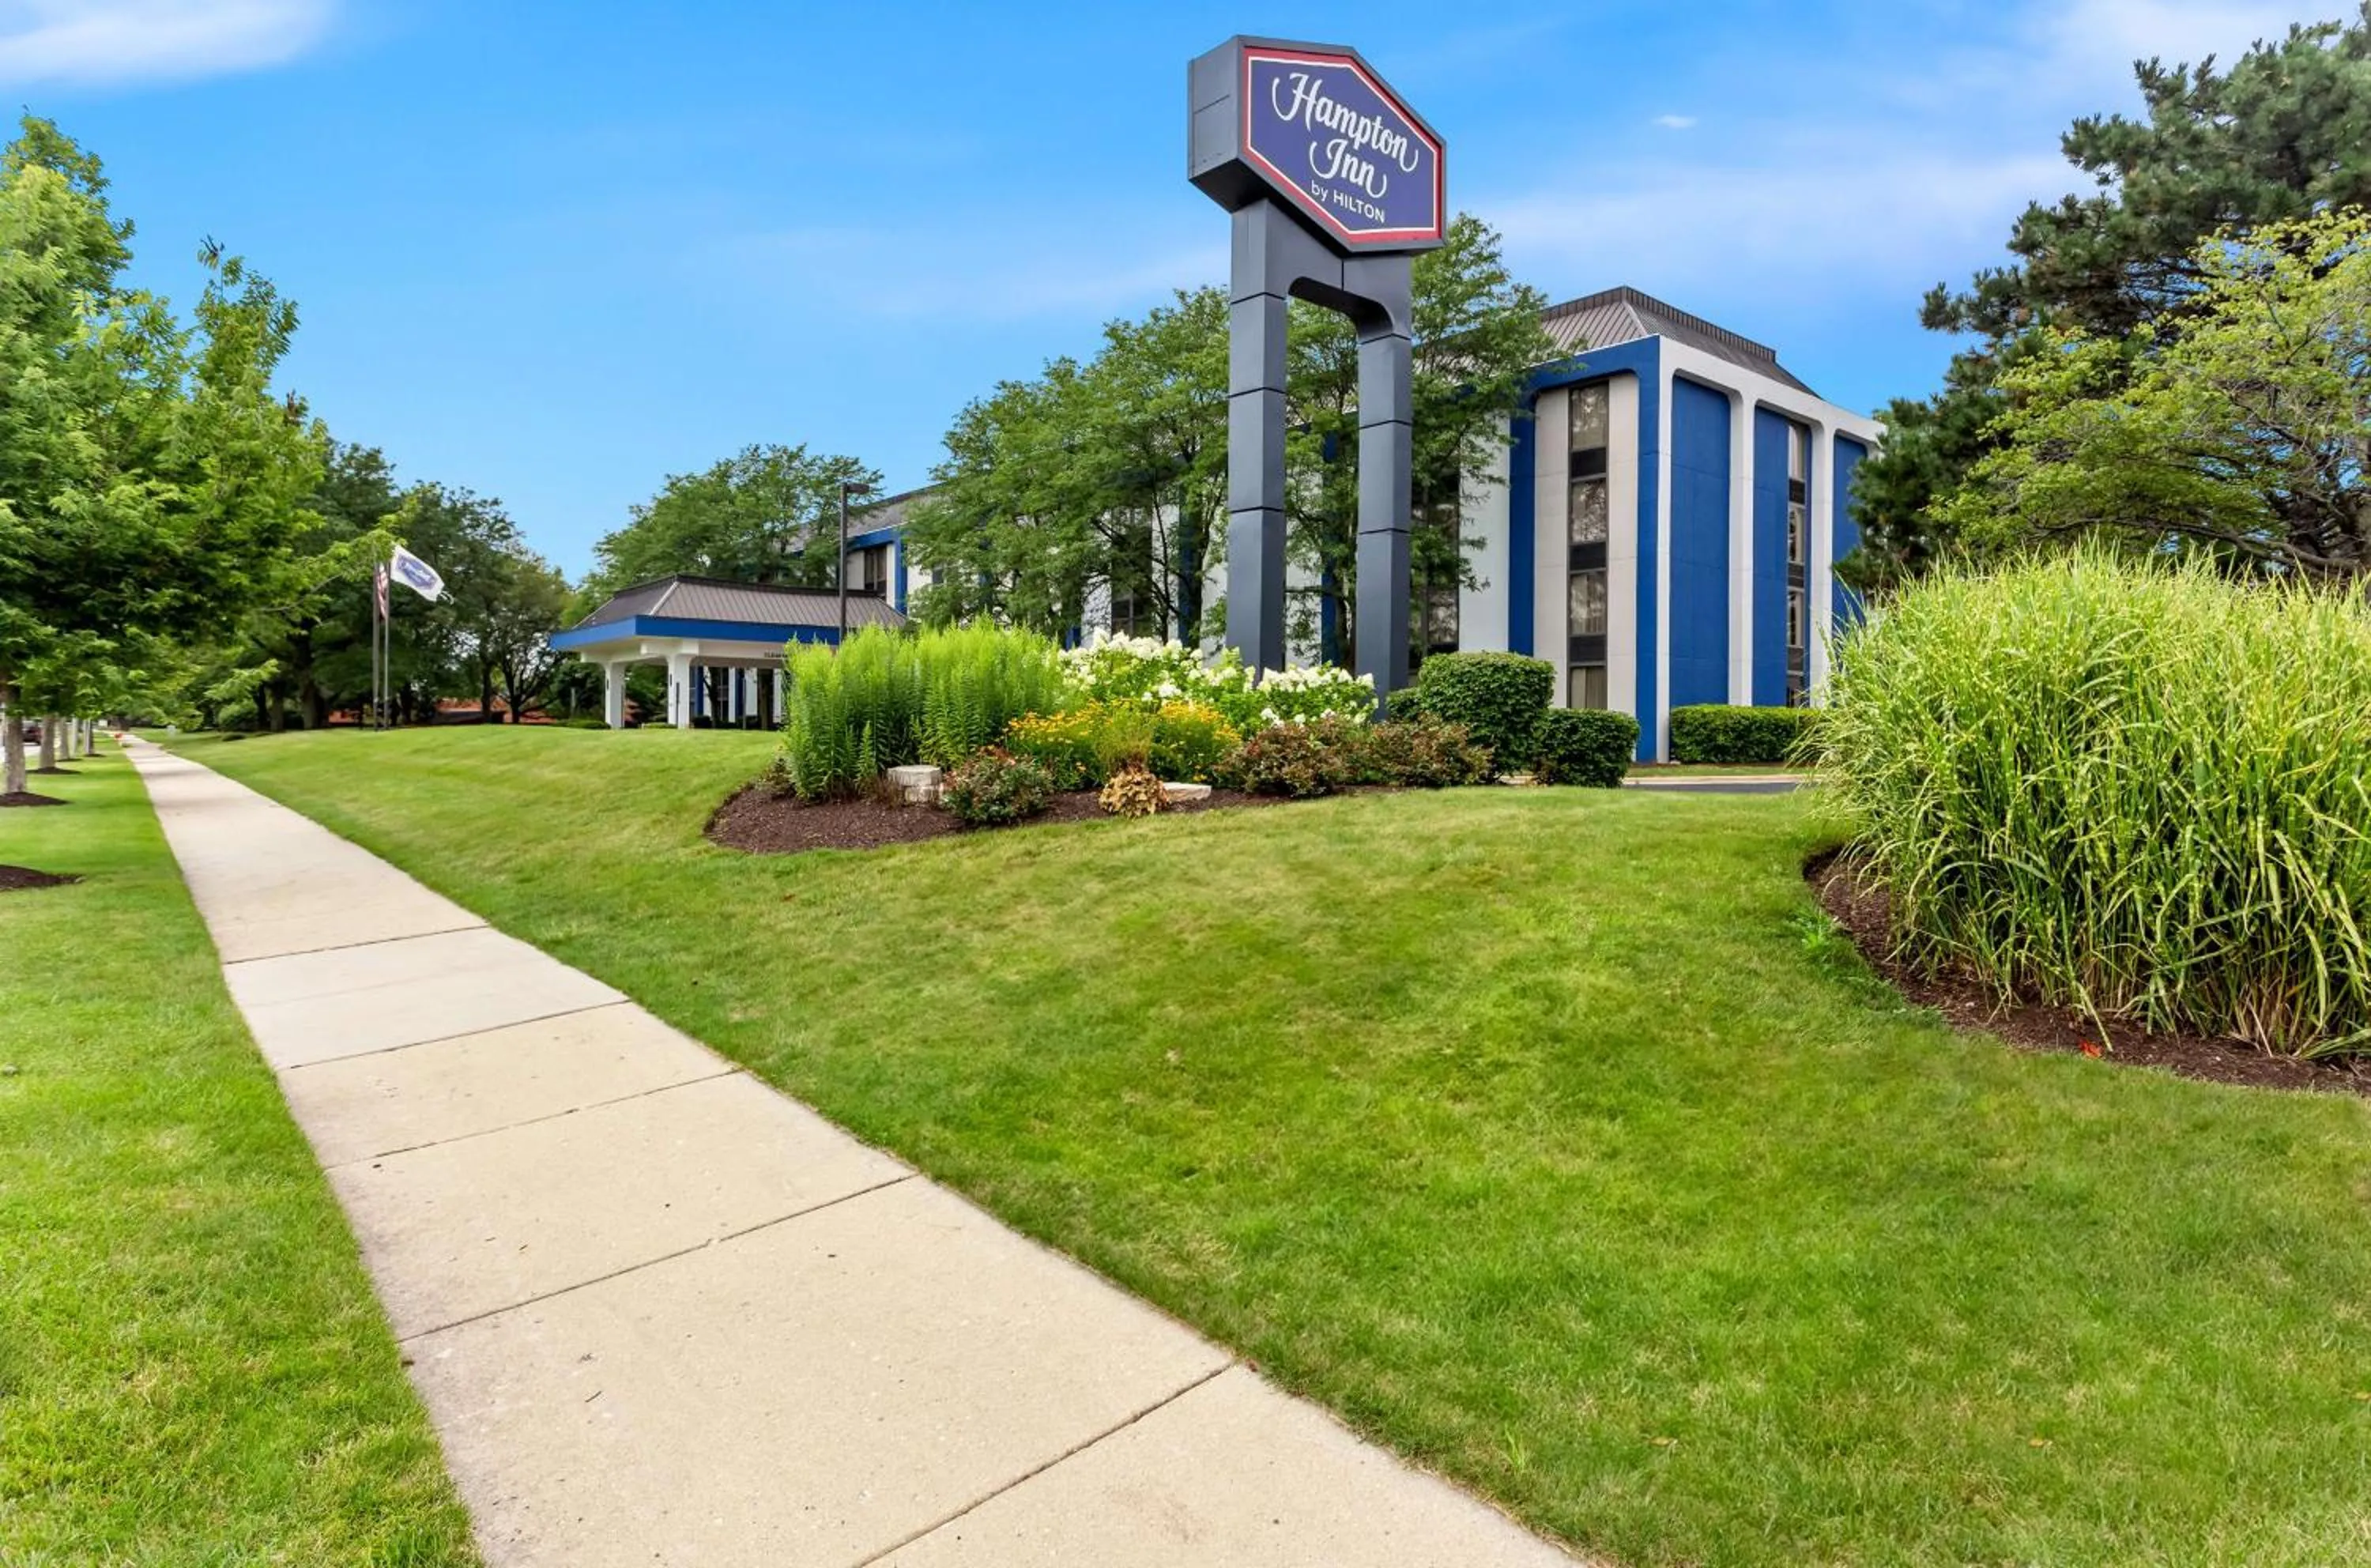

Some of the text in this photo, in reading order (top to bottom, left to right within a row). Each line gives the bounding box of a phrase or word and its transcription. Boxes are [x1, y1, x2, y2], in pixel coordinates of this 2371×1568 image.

[1272, 72, 1419, 172] Hampton
[1309, 138, 1387, 198] Inn
[1310, 179, 1385, 223] by HILTON
